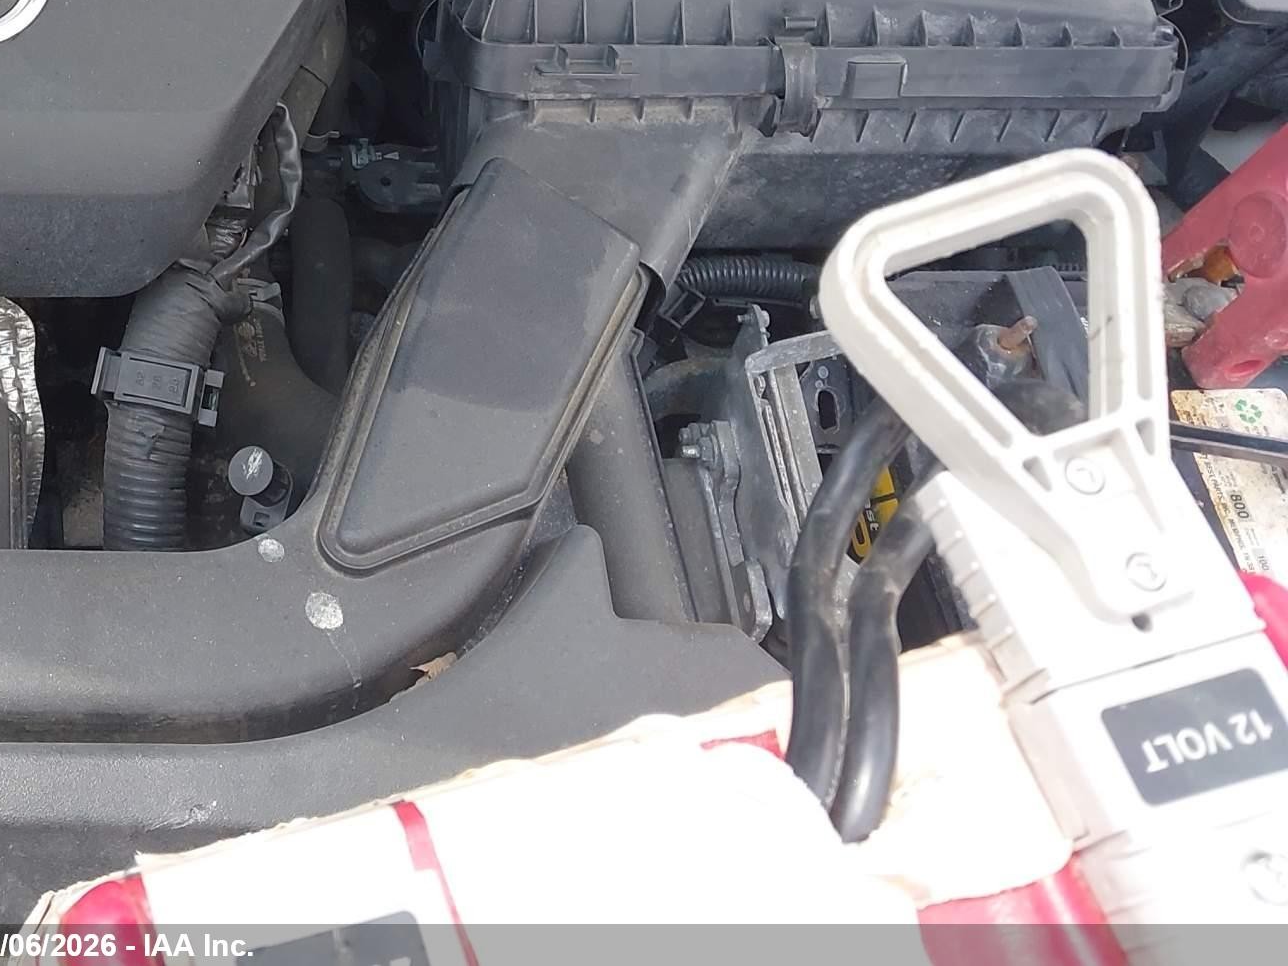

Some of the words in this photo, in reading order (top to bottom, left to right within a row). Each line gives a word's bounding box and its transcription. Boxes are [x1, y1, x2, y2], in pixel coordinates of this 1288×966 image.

[1230, 494, 1250, 520] 800
[1227, 708, 1273, 745] 12
[1141, 721, 1233, 773] VOLT
